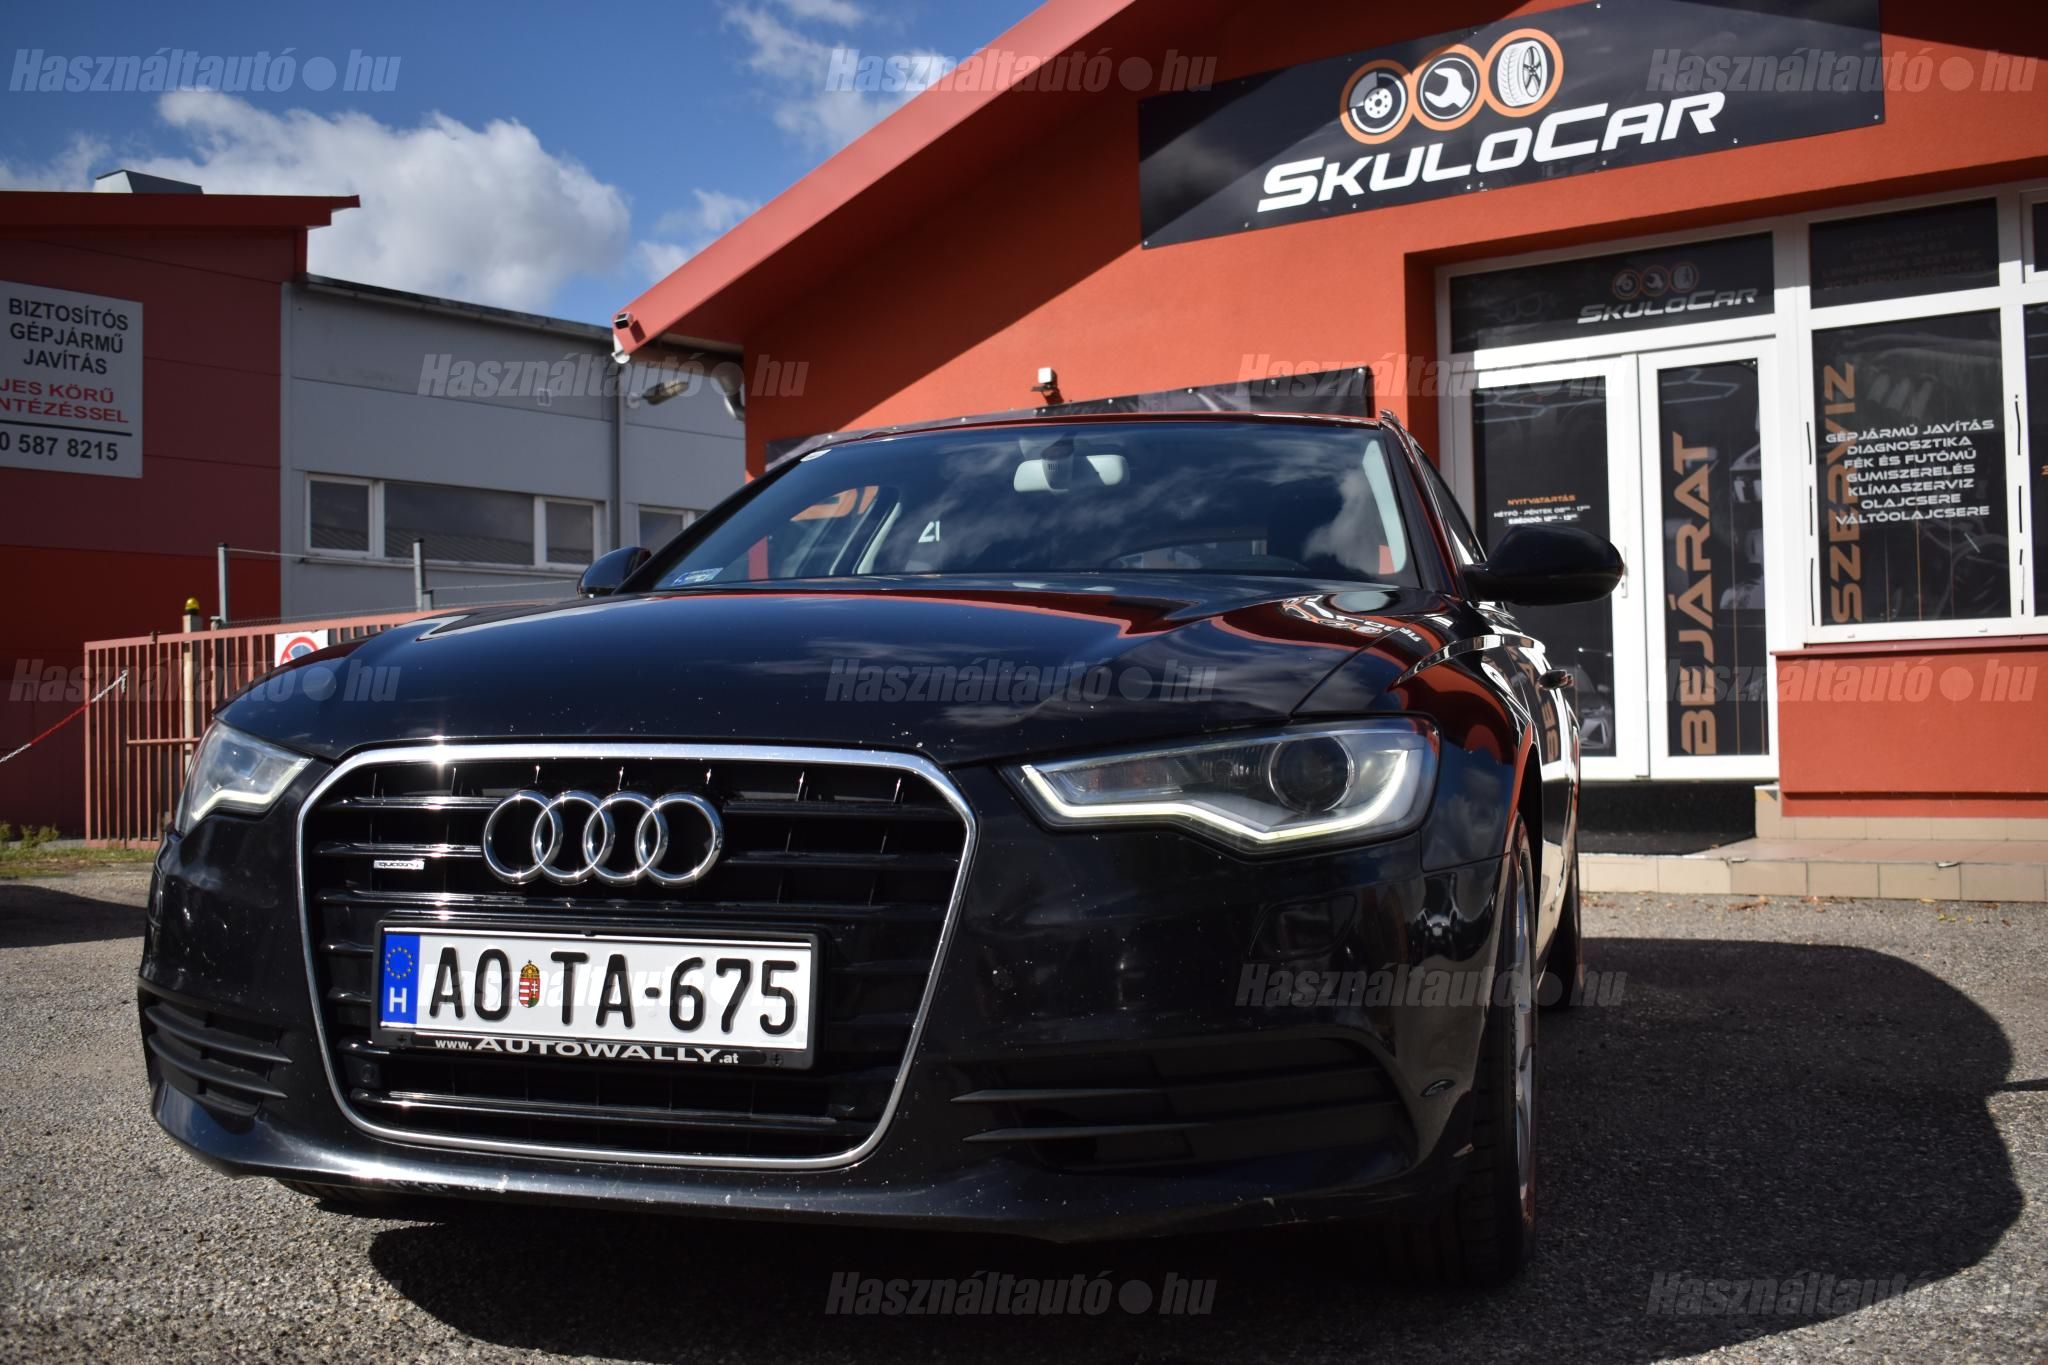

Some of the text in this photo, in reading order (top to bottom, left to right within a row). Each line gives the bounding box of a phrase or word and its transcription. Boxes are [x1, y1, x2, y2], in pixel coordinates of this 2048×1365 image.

[1257, 91, 1726, 213] SKULOCAR
[8, 298, 129, 331] BIZTOSÍTÓS
[10, 322, 124, 354] GÉPJÁRMŰ
[23, 349, 108, 375] JAVÍTÁS
[49, 383, 114, 404] KÖRŰ
[1826, 419, 1996, 444] GÉPJÁRMŰ JAVÍTÁS
[18, 434, 59, 457] 587
[67, 438, 118, 462] 8215
[1844, 447, 1977, 470] FÉK ÉS FUTÓMŰ
[1847, 436, 1973, 456] DIAGNOSZTIKA
[1846, 463, 1976, 483] GUMISZERELÉS
[1823, 362, 1863, 624] SZERVIZ
[1847, 478, 1975, 497] KLÍMASZERVIZ
[1860, 493, 1962, 510] OLAJCSERE
[1836, 506, 1991, 526] VÁLTÓOLAJCSERE
[1668, 431, 1718, 756] BEJÁRAT
[389, 986, 408, 1014] H
[429, 946, 799, 1036] AO TA-675
